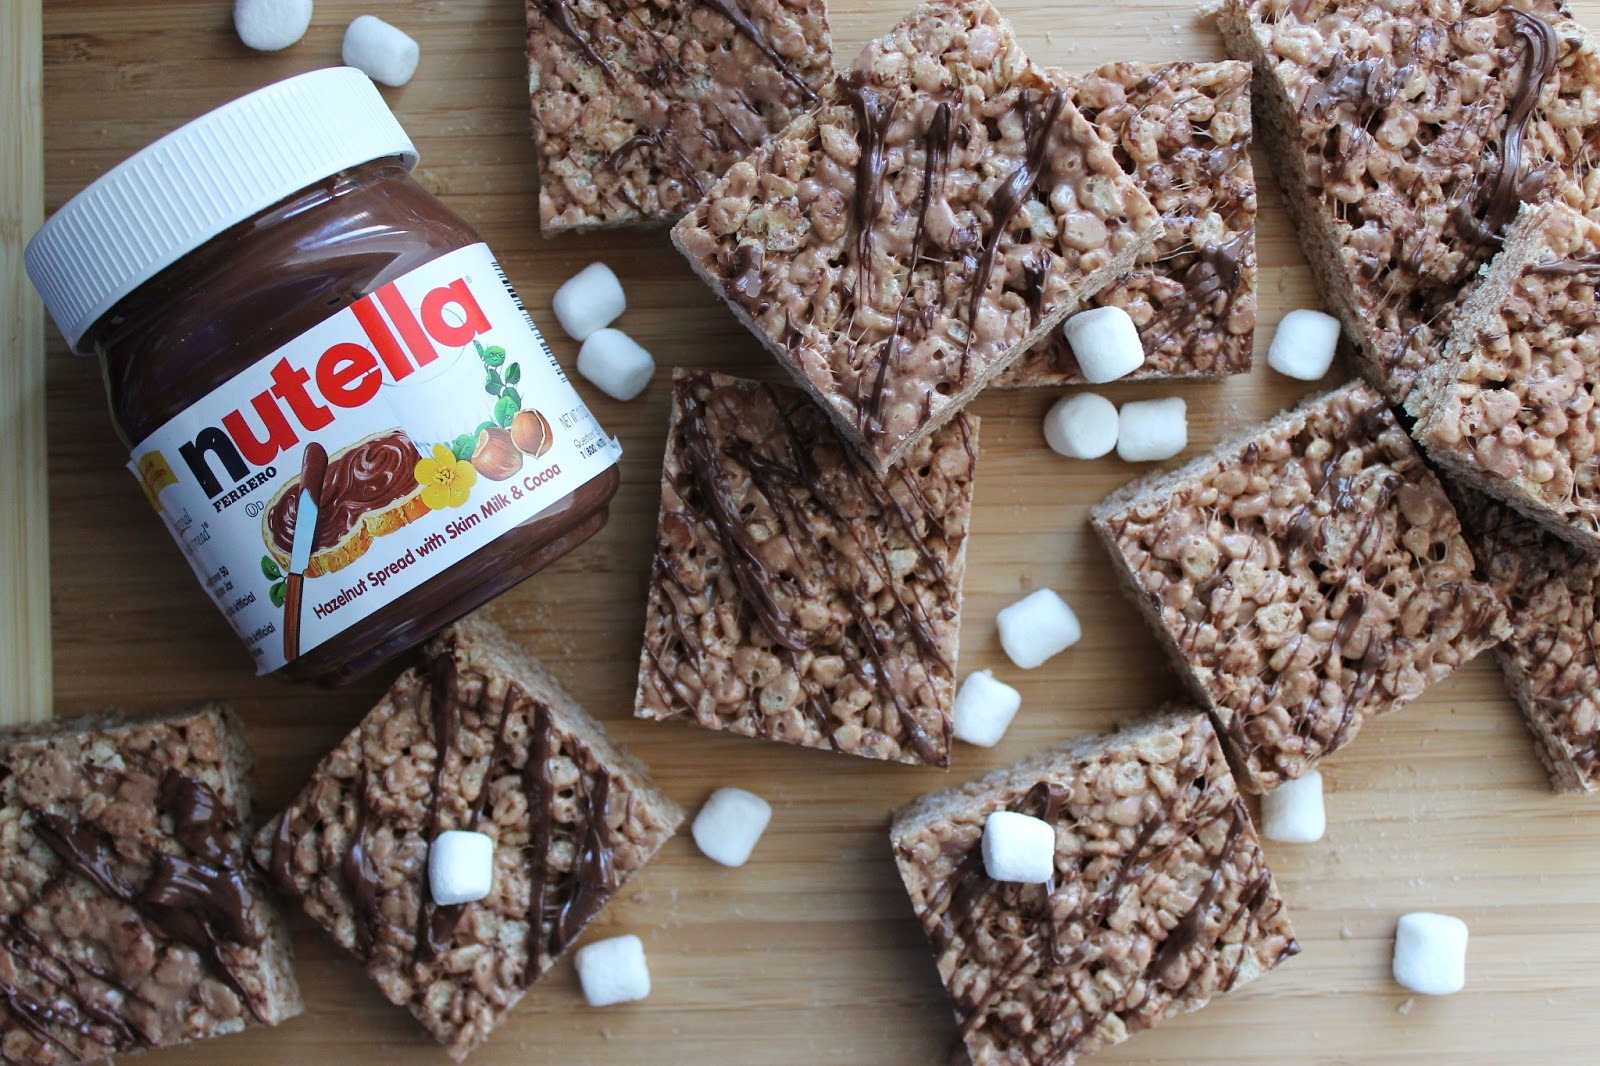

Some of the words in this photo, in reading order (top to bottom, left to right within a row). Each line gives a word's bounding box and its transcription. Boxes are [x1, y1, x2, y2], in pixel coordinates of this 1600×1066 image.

[178, 277, 493, 500] nutella
[212, 466, 277, 513] FERRERO
[312, 577, 369, 620] Hazelnut
[367, 548, 417, 587] Spread
[415, 533, 447, 558] with
[445, 514, 482, 540] Skim
[480, 494, 512, 519] Milk
[510, 485, 525, 500] &
[523, 462, 562, 491] Cocoa
